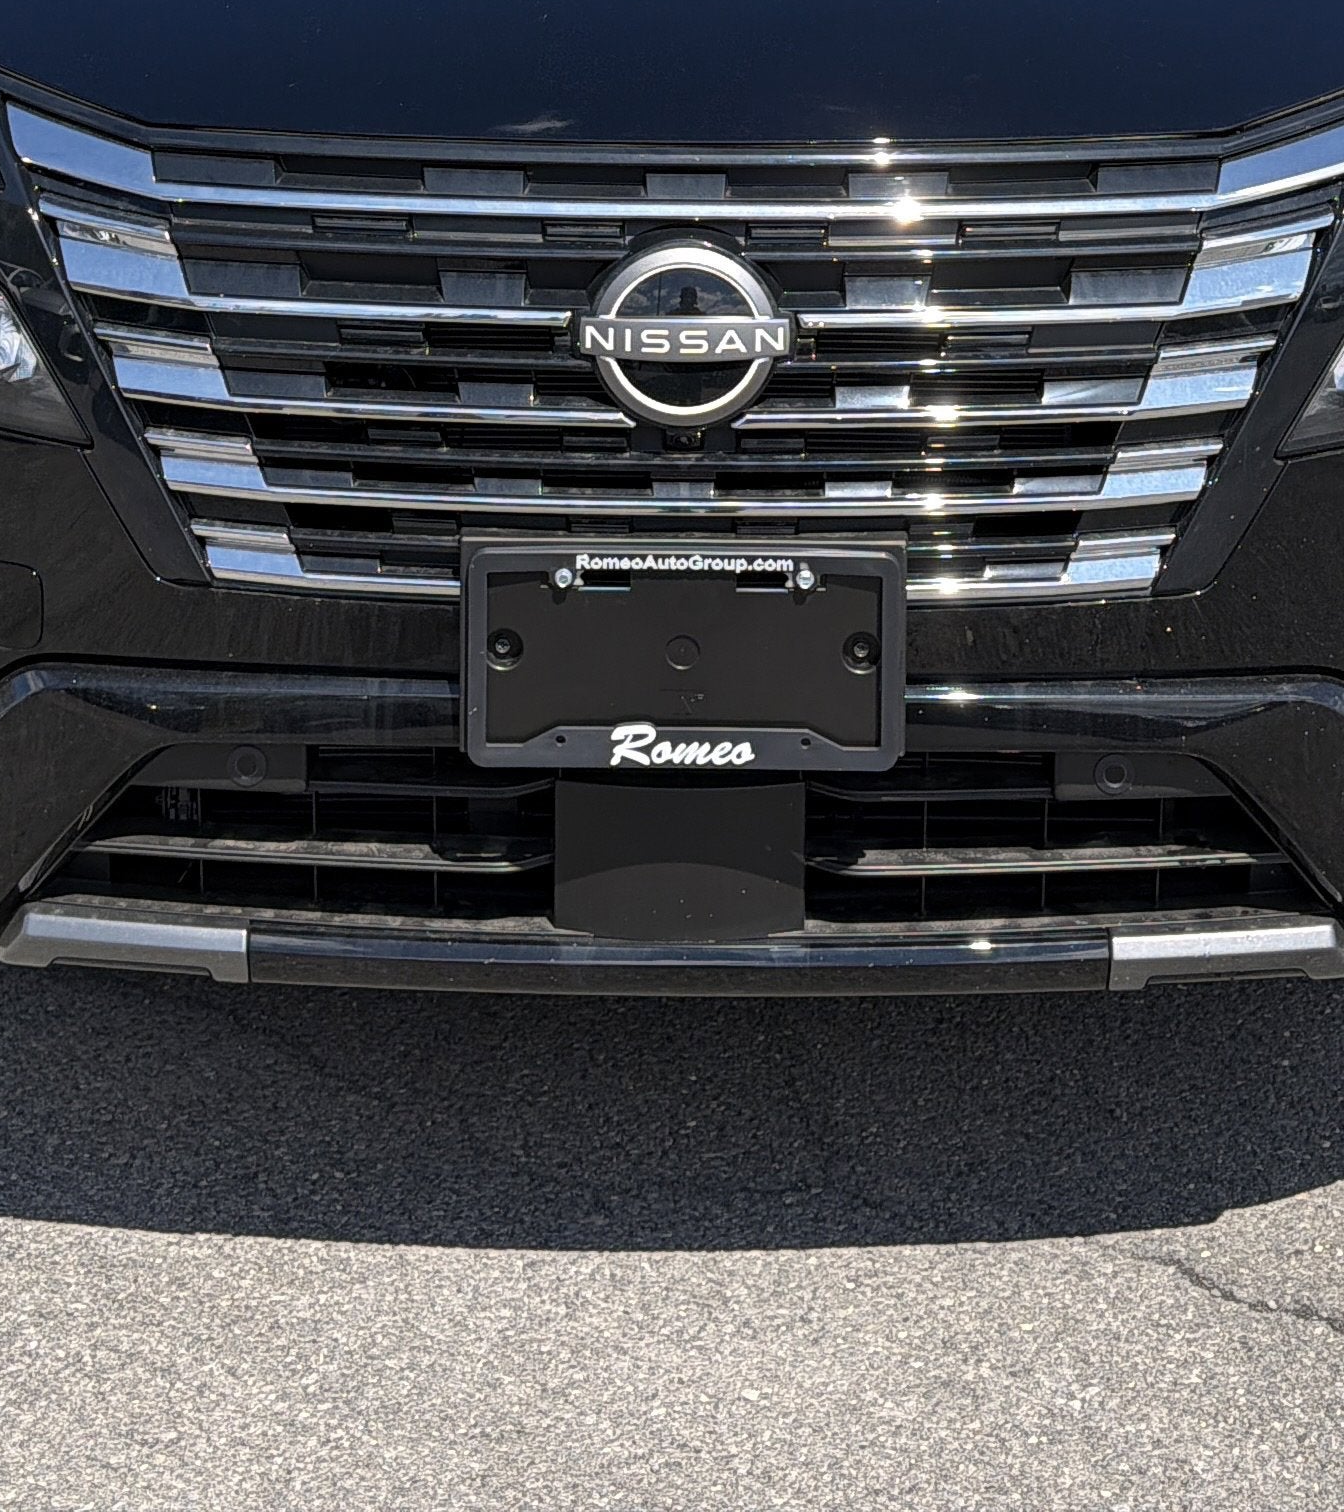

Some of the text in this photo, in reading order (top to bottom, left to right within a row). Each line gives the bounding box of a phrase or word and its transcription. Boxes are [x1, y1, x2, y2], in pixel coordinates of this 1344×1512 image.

[585, 325, 785, 354] NISSAN
[575, 554, 794, 573] RomeoAutoGroup.com
[610, 723, 755, 766] Romeo
